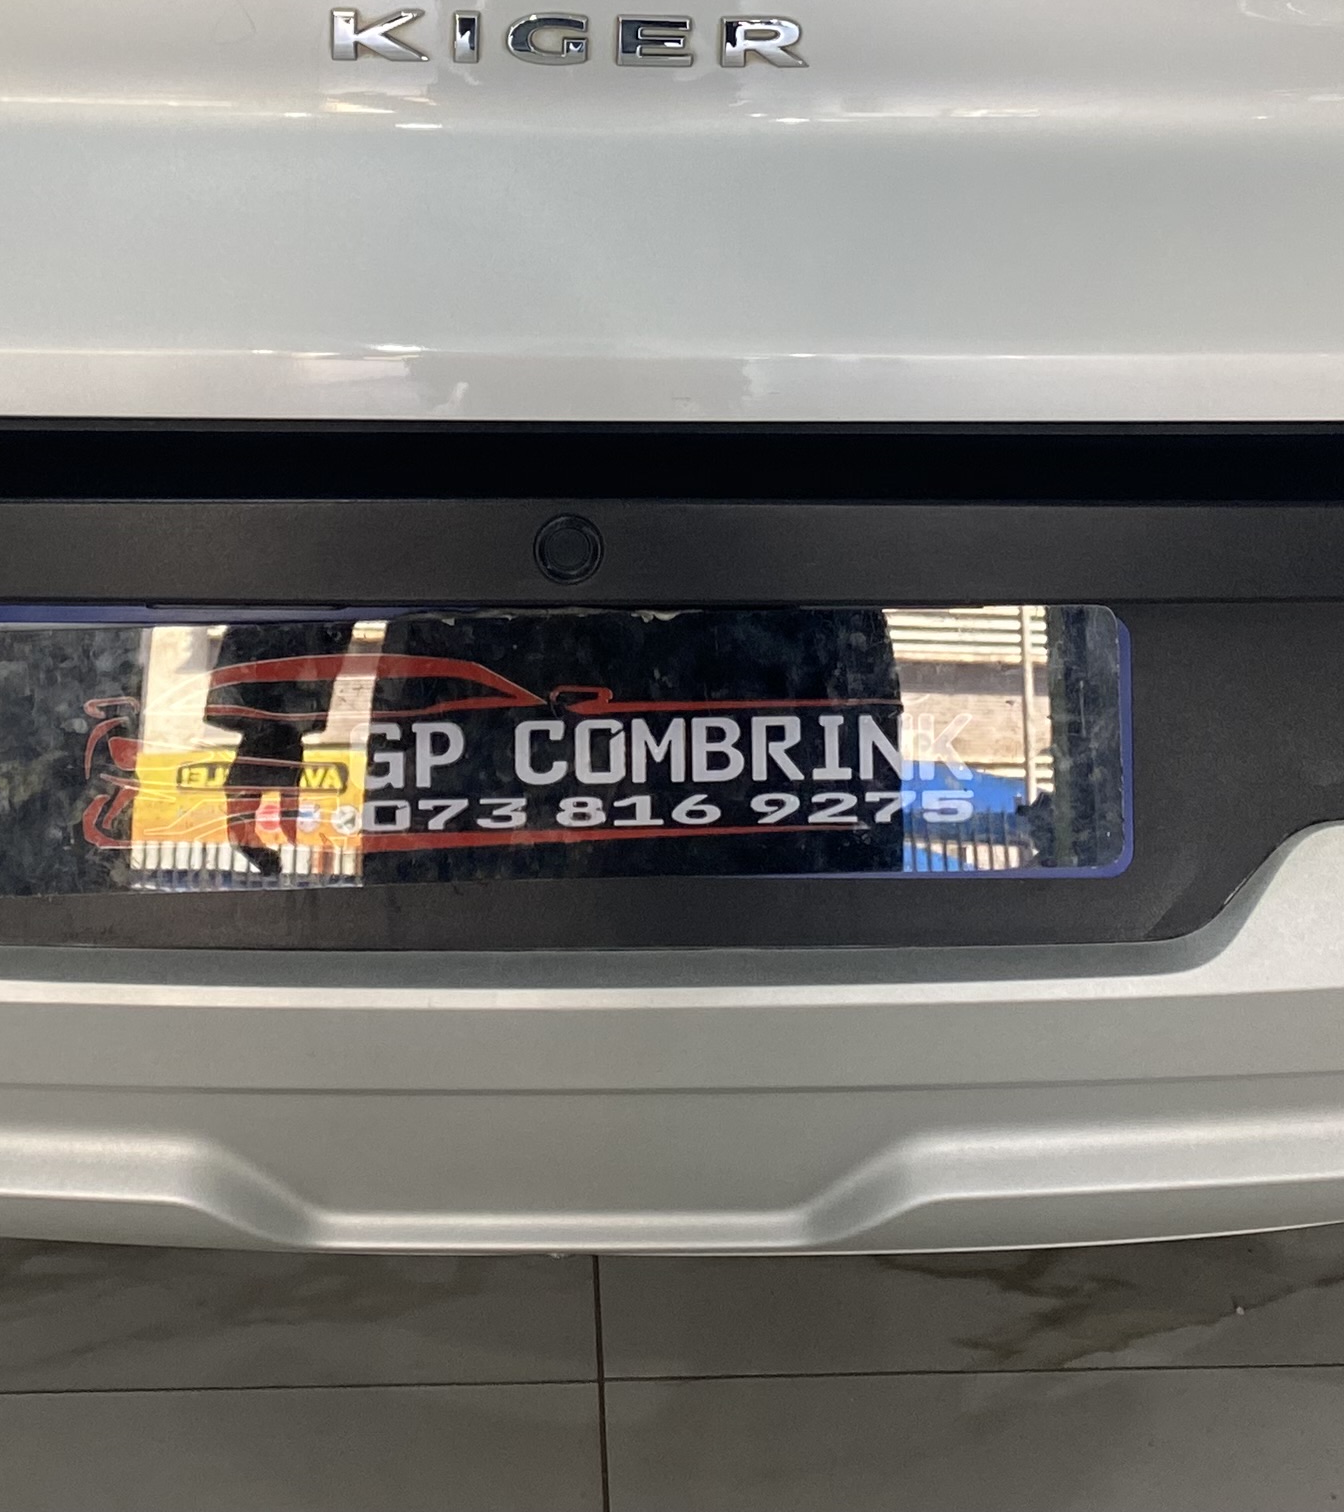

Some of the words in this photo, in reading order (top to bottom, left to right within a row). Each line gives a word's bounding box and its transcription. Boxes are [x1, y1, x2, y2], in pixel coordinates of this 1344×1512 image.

[331, 7, 809, 69] KIGER
[350, 720, 465, 790] GP
[514, 713, 974, 785] COMBRINK
[360, 797, 528, 832] 073
[556, 794, 722, 828] 816
[750, 789, 975, 825] 9275
